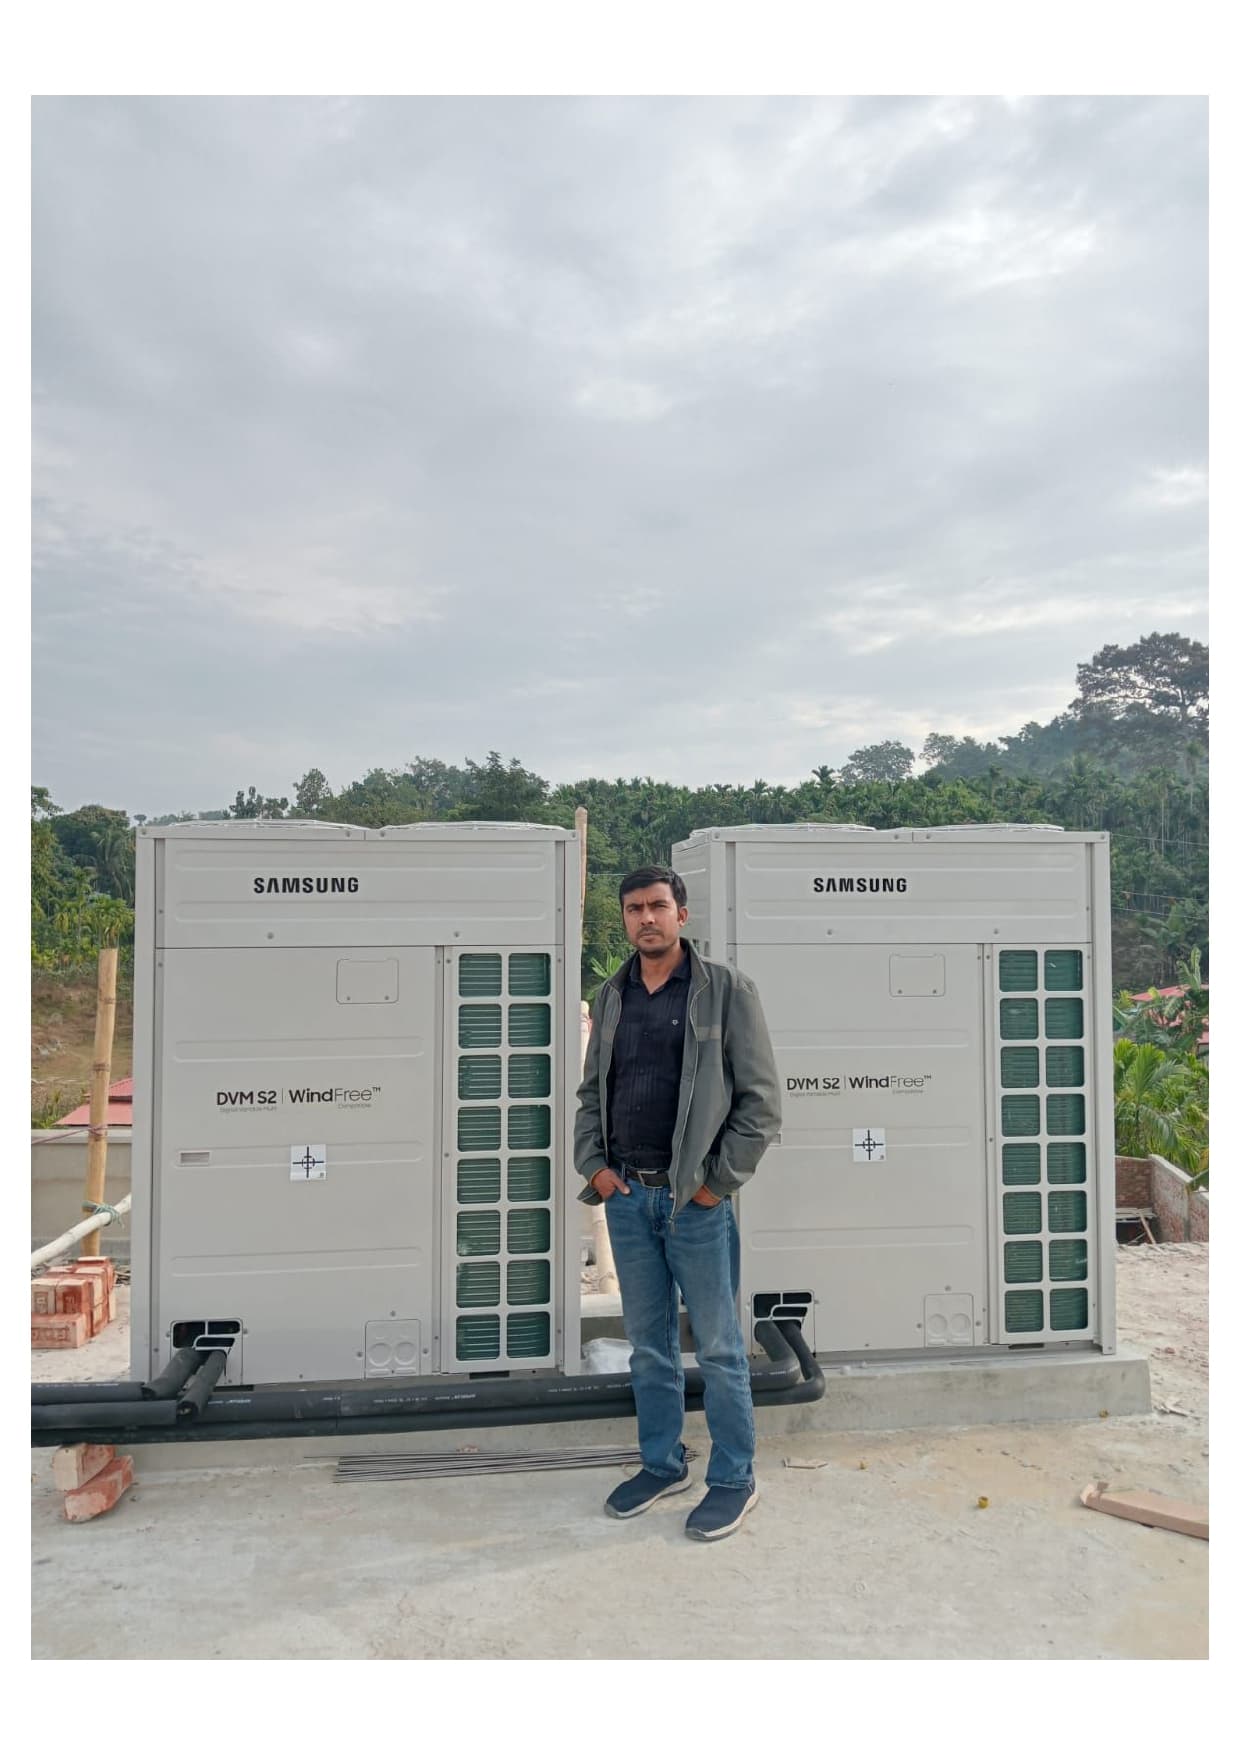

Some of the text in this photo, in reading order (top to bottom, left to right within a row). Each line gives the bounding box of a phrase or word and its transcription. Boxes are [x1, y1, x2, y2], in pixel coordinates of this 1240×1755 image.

[253, 876, 359, 894] SAMSUNG
[813, 877, 908, 893] SAMSUNG
[787, 1077, 819, 1091] DVM
[822, 1077, 841, 1090] S2
[216, 1091, 254, 1106] DVM
[257, 1090, 277, 1104] S2
